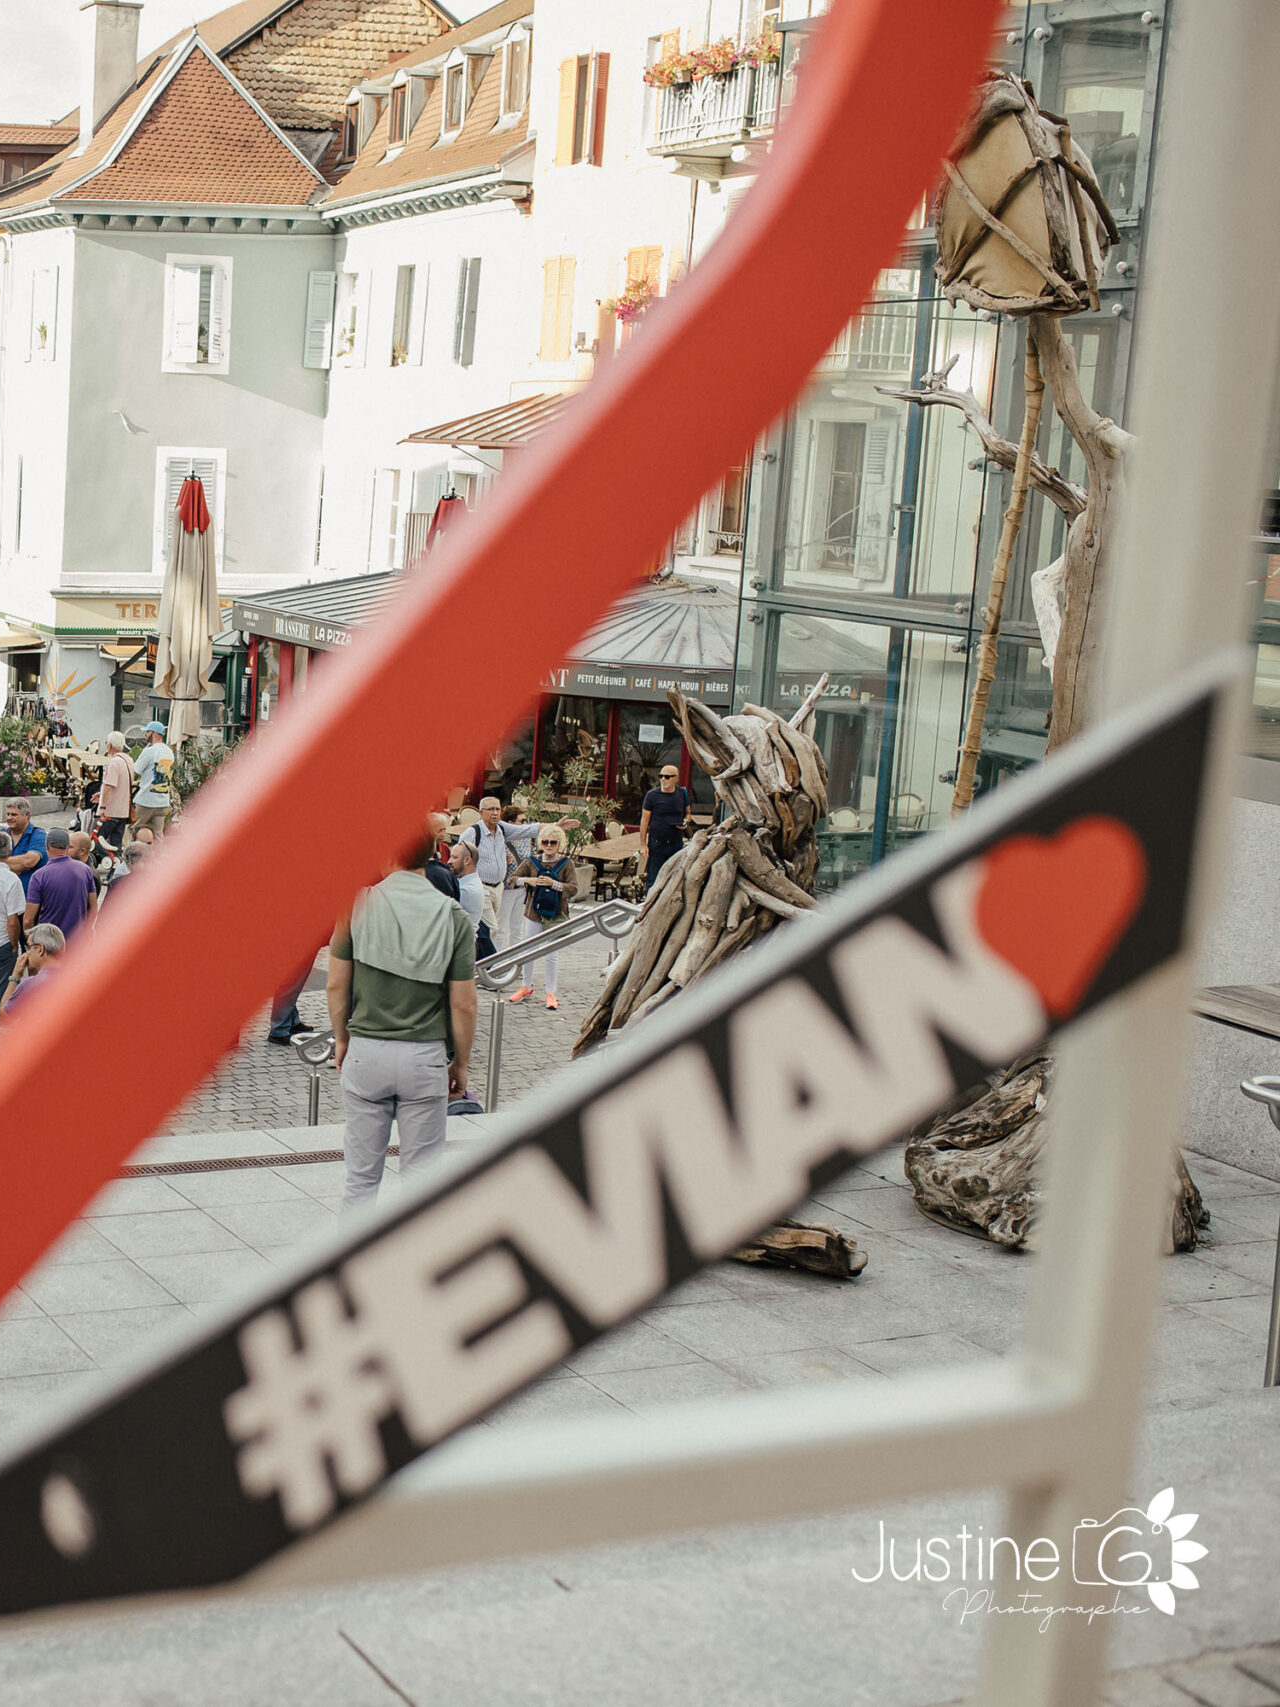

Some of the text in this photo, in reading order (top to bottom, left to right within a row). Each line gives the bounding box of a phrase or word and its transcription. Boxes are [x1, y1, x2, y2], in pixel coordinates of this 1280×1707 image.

[116, 603, 157, 619] TER
[275, 616, 353, 647] BRASSERIE LA PIZZA
[577, 673, 594, 684] PETIT
[595, 673, 627, 687] DÉJEUNER
[635, 677, 652, 688] CAFÉ
[681, 681, 700, 692] HOUR
[705, 681, 729, 693] BIÈRES
[780, 684, 852, 697] LA PZZA
[223, 858, 1050, 1533] #EVIAN
